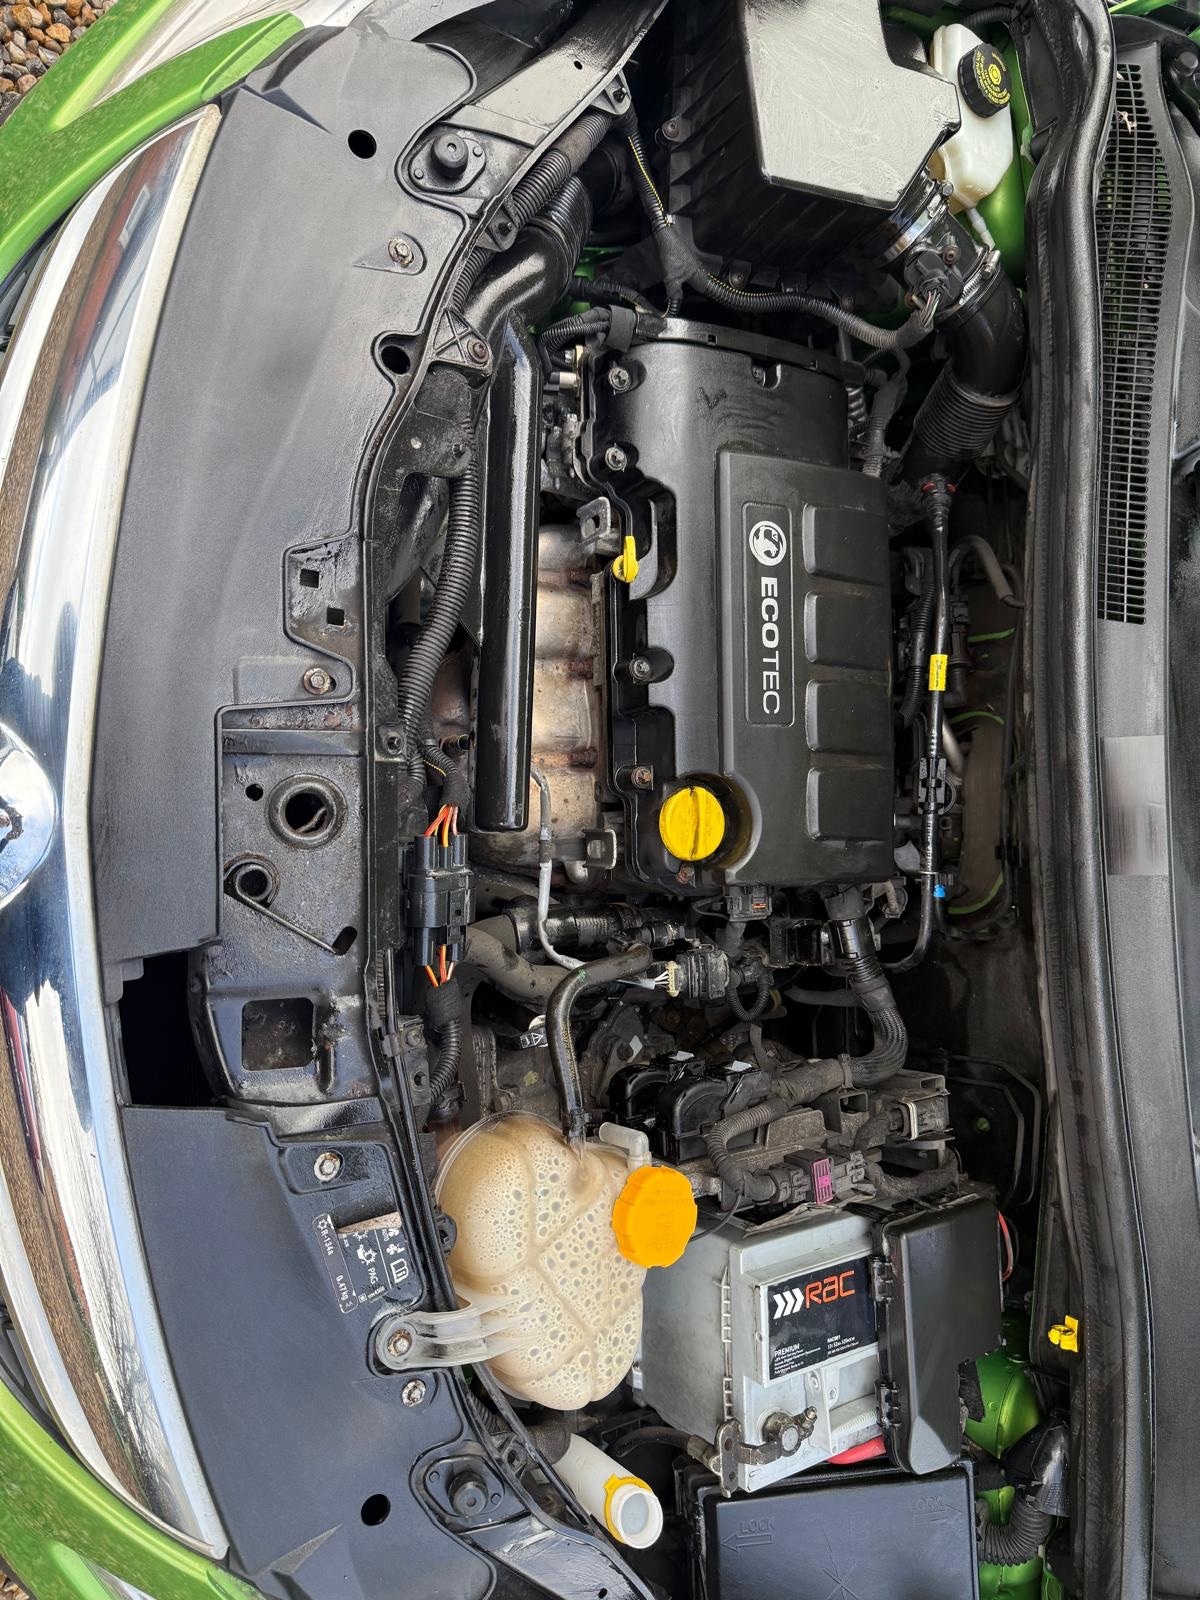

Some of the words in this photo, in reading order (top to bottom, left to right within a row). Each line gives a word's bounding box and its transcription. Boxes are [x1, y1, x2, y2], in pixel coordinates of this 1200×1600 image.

[760, 576, 781, 715] ECOTEC
[320, 1229, 334, 1256] R-134a
[367, 1267, 379, 1285] PAG
[774, 1343, 800, 1358] PREMIUM
[740, 1516, 776, 1534] LOCK
